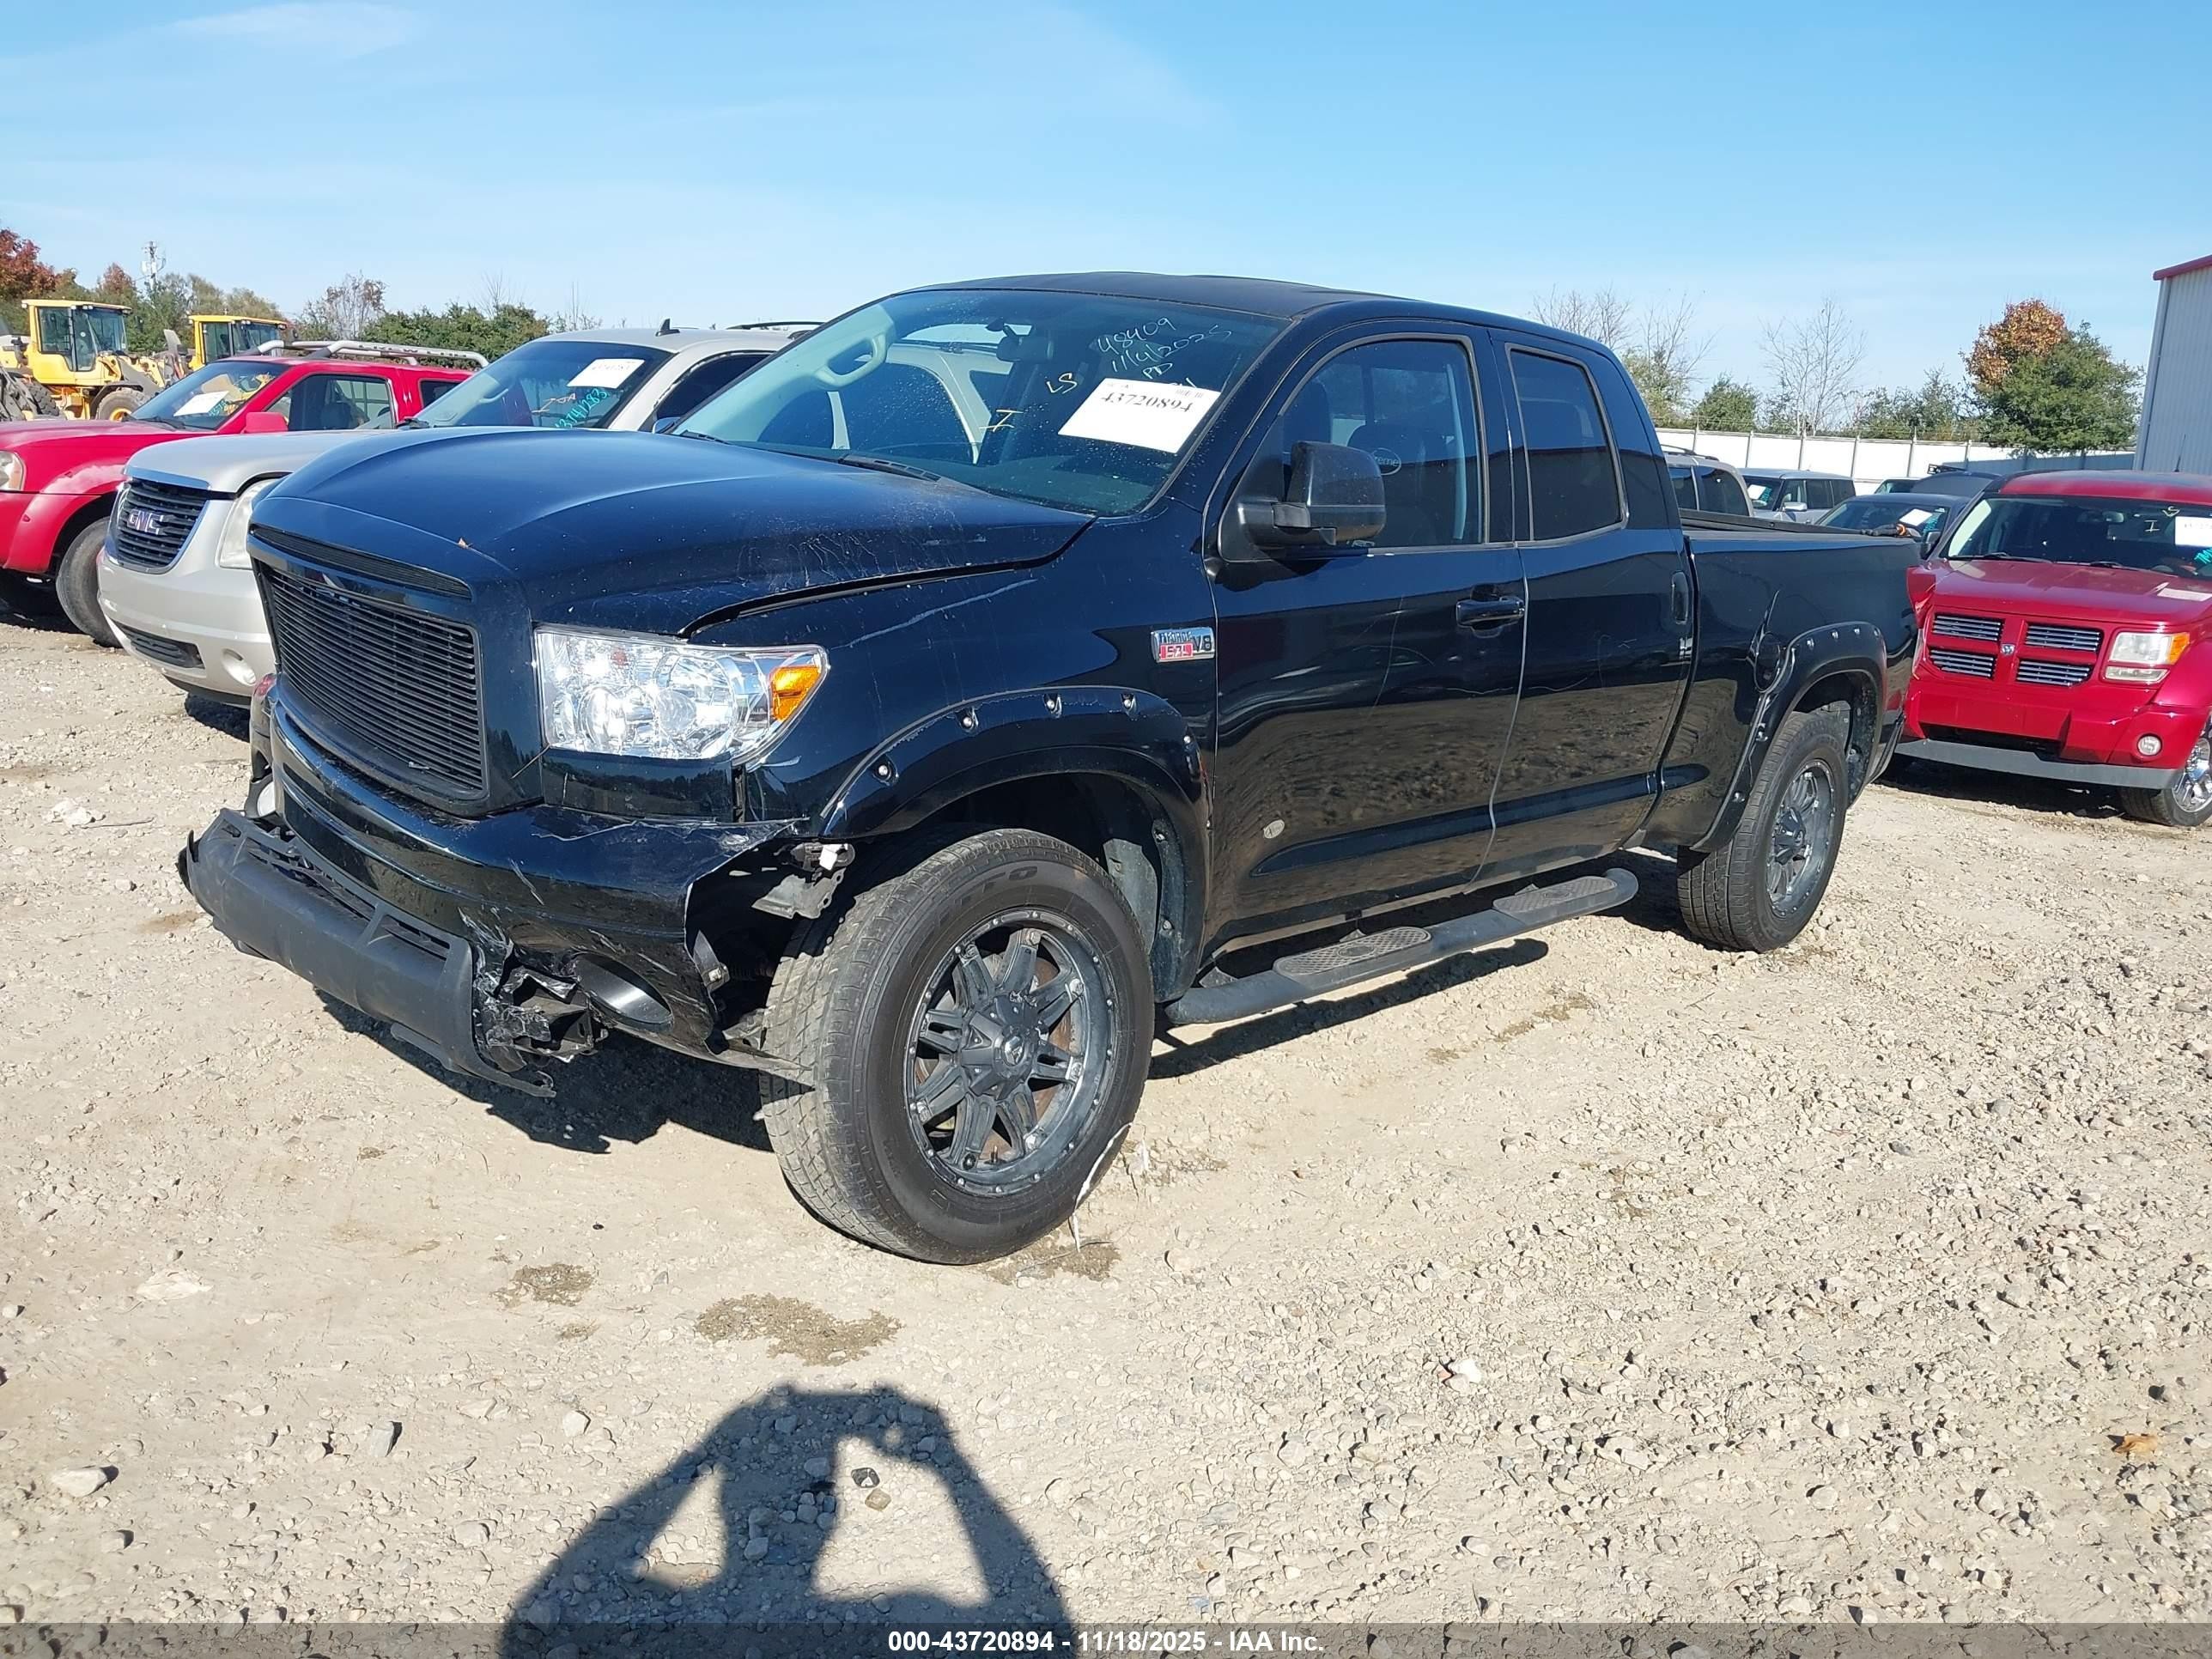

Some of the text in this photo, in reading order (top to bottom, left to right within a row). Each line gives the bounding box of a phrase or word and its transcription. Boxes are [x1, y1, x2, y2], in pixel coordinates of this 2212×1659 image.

[1097, 317, 1176, 356] 48409
[556, 388, 608, 428] 3741283
[1101, 392, 1194, 413] 43720894
[127, 509, 164, 535] GMC
[1191, 634, 1212, 653] V8
